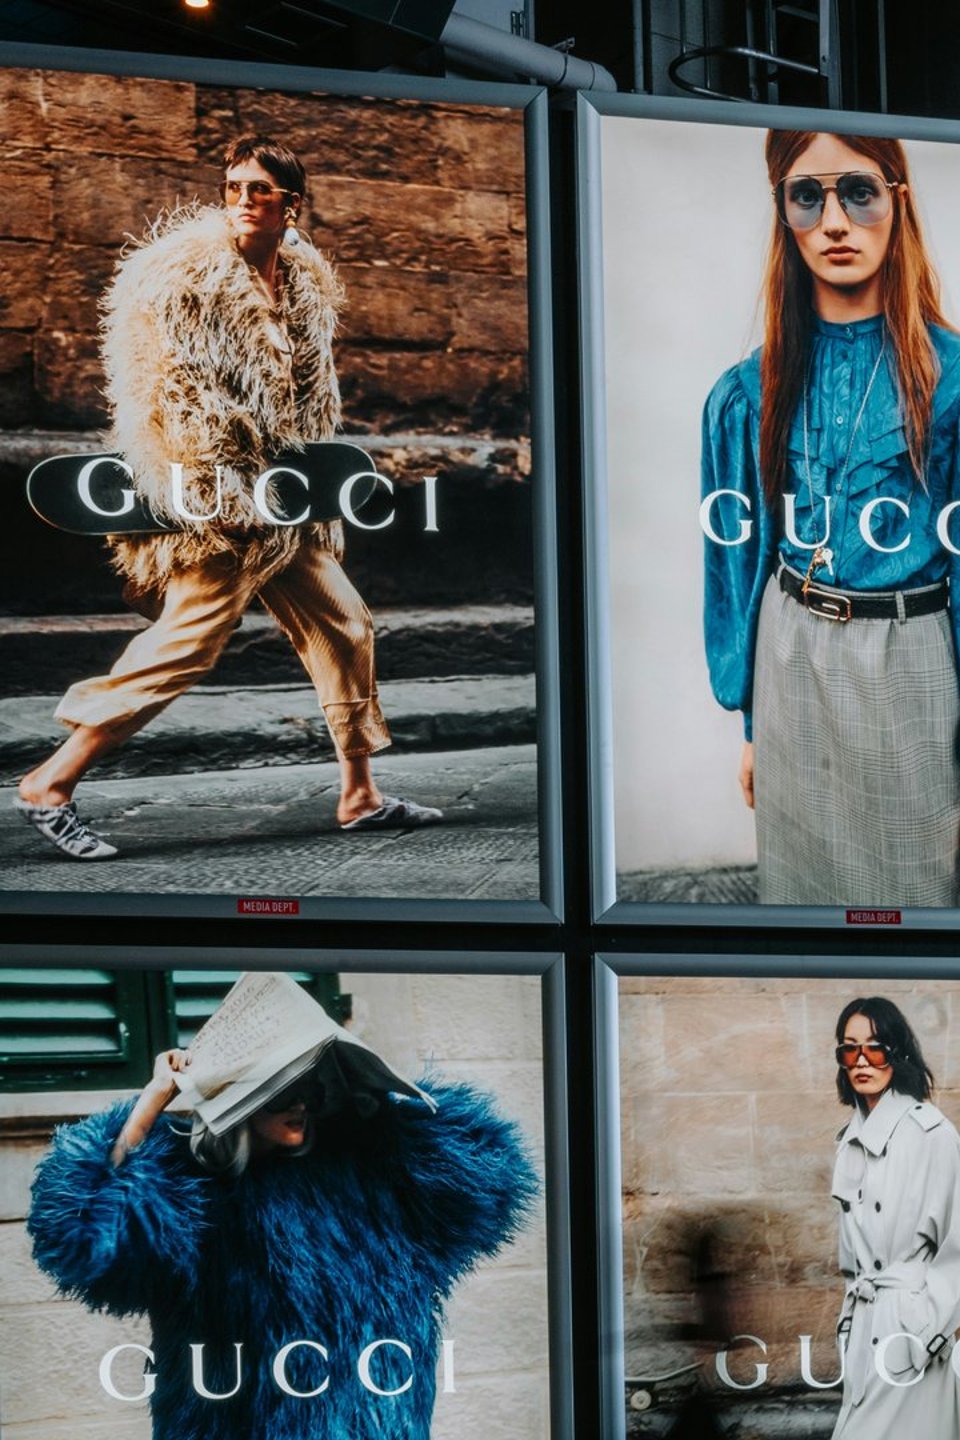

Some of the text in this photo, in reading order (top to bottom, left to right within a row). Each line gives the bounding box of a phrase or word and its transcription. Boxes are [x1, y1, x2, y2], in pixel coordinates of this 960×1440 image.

[77, 457, 440, 532] GUCCI
[243, 901, 296, 913] MEDIA DEPT.
[850, 912, 899, 923] MEDIA DEPT.
[98, 1339, 457, 1401] GUCCI
